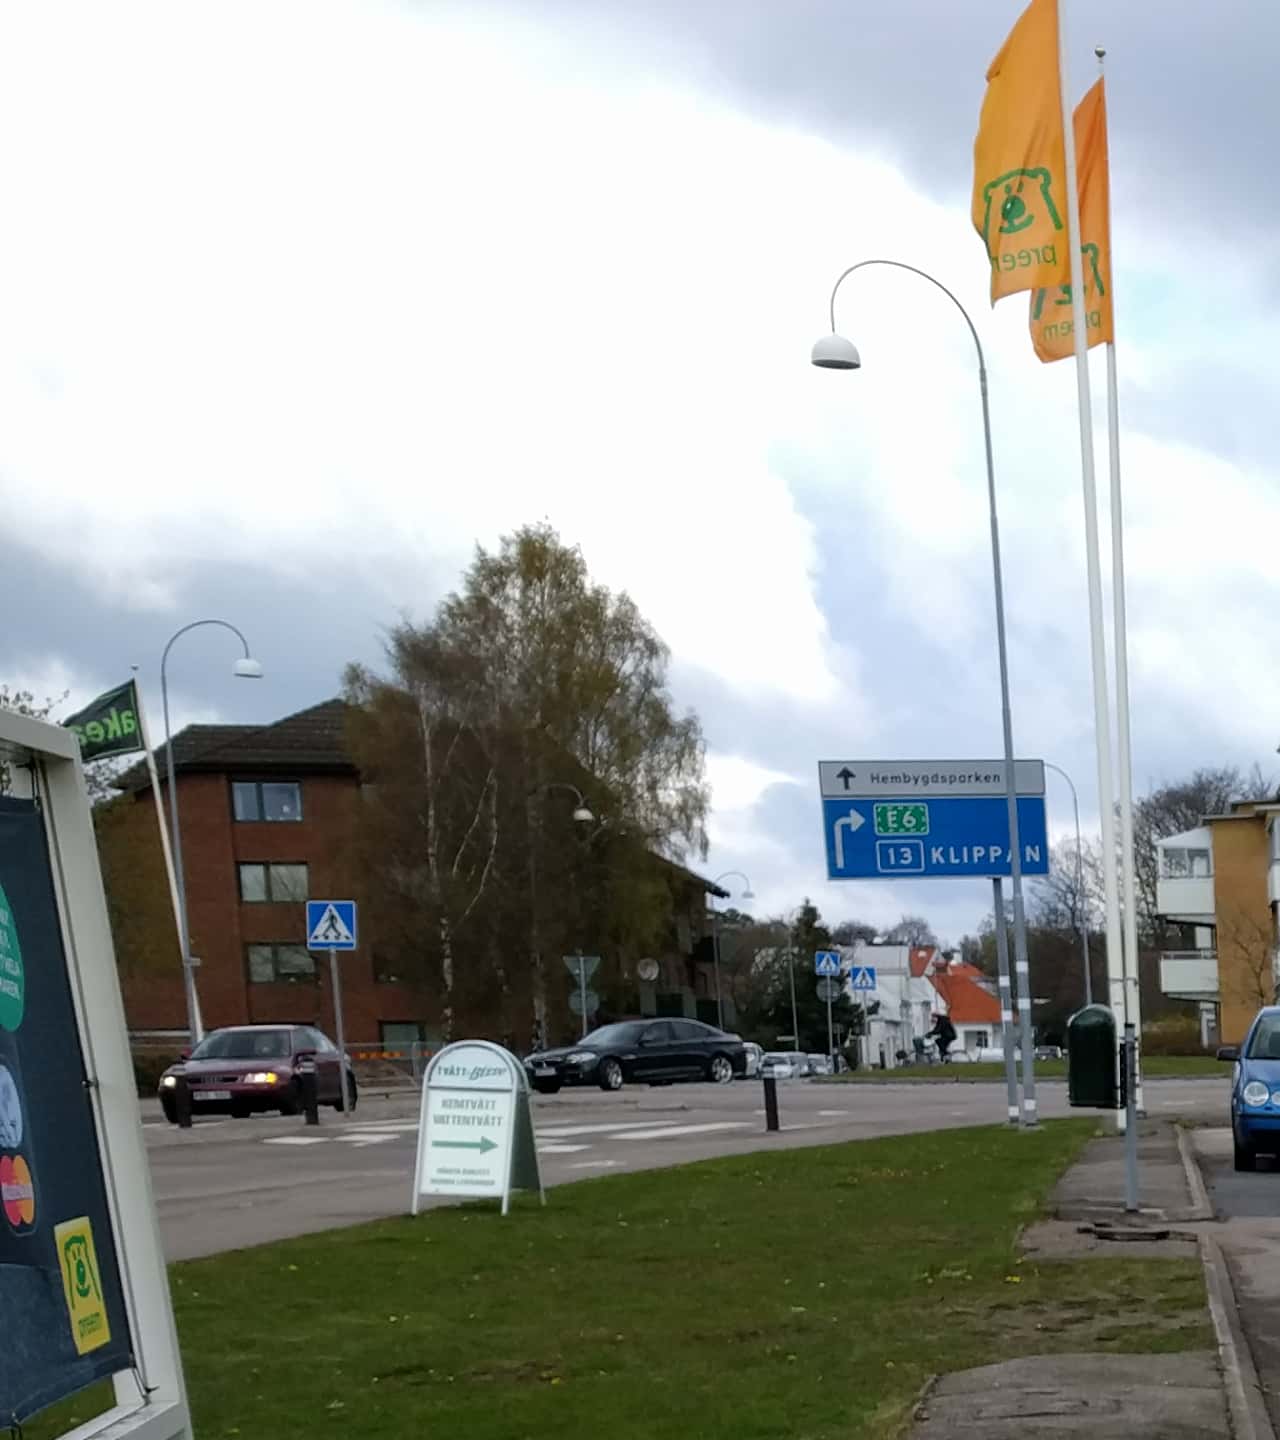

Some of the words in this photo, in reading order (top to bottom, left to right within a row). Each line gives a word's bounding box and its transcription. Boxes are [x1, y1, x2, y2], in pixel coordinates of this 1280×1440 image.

[870, 772, 1001, 786] Hembygdsparken
[886, 809, 917, 828] E6
[887, 847, 913, 865] 13
[931, 845, 1040, 865] KLIPPN
